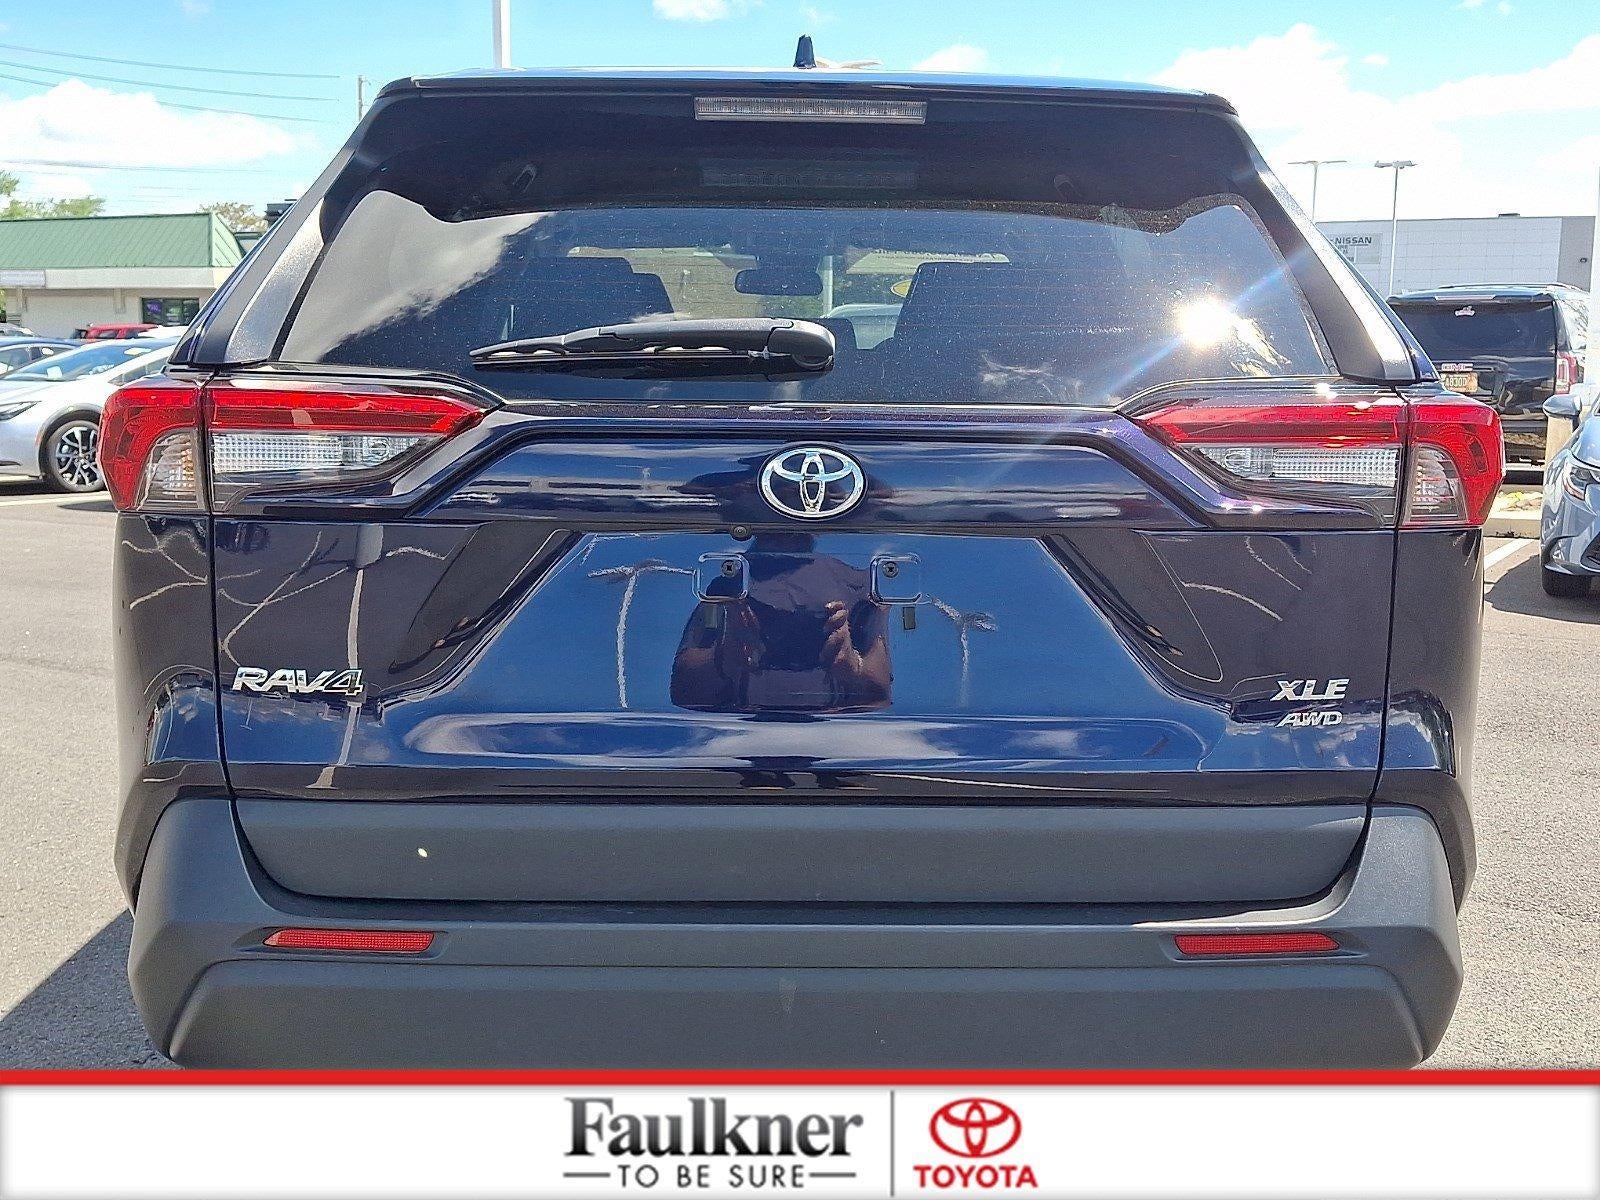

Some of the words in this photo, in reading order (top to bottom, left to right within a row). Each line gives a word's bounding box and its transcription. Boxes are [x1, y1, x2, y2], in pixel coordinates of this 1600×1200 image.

[1335, 236, 1372, 244] NISSAN
[232, 667, 363, 696] RAV4
[1270, 678, 1350, 701] XLE
[1275, 711, 1343, 727] AWD
